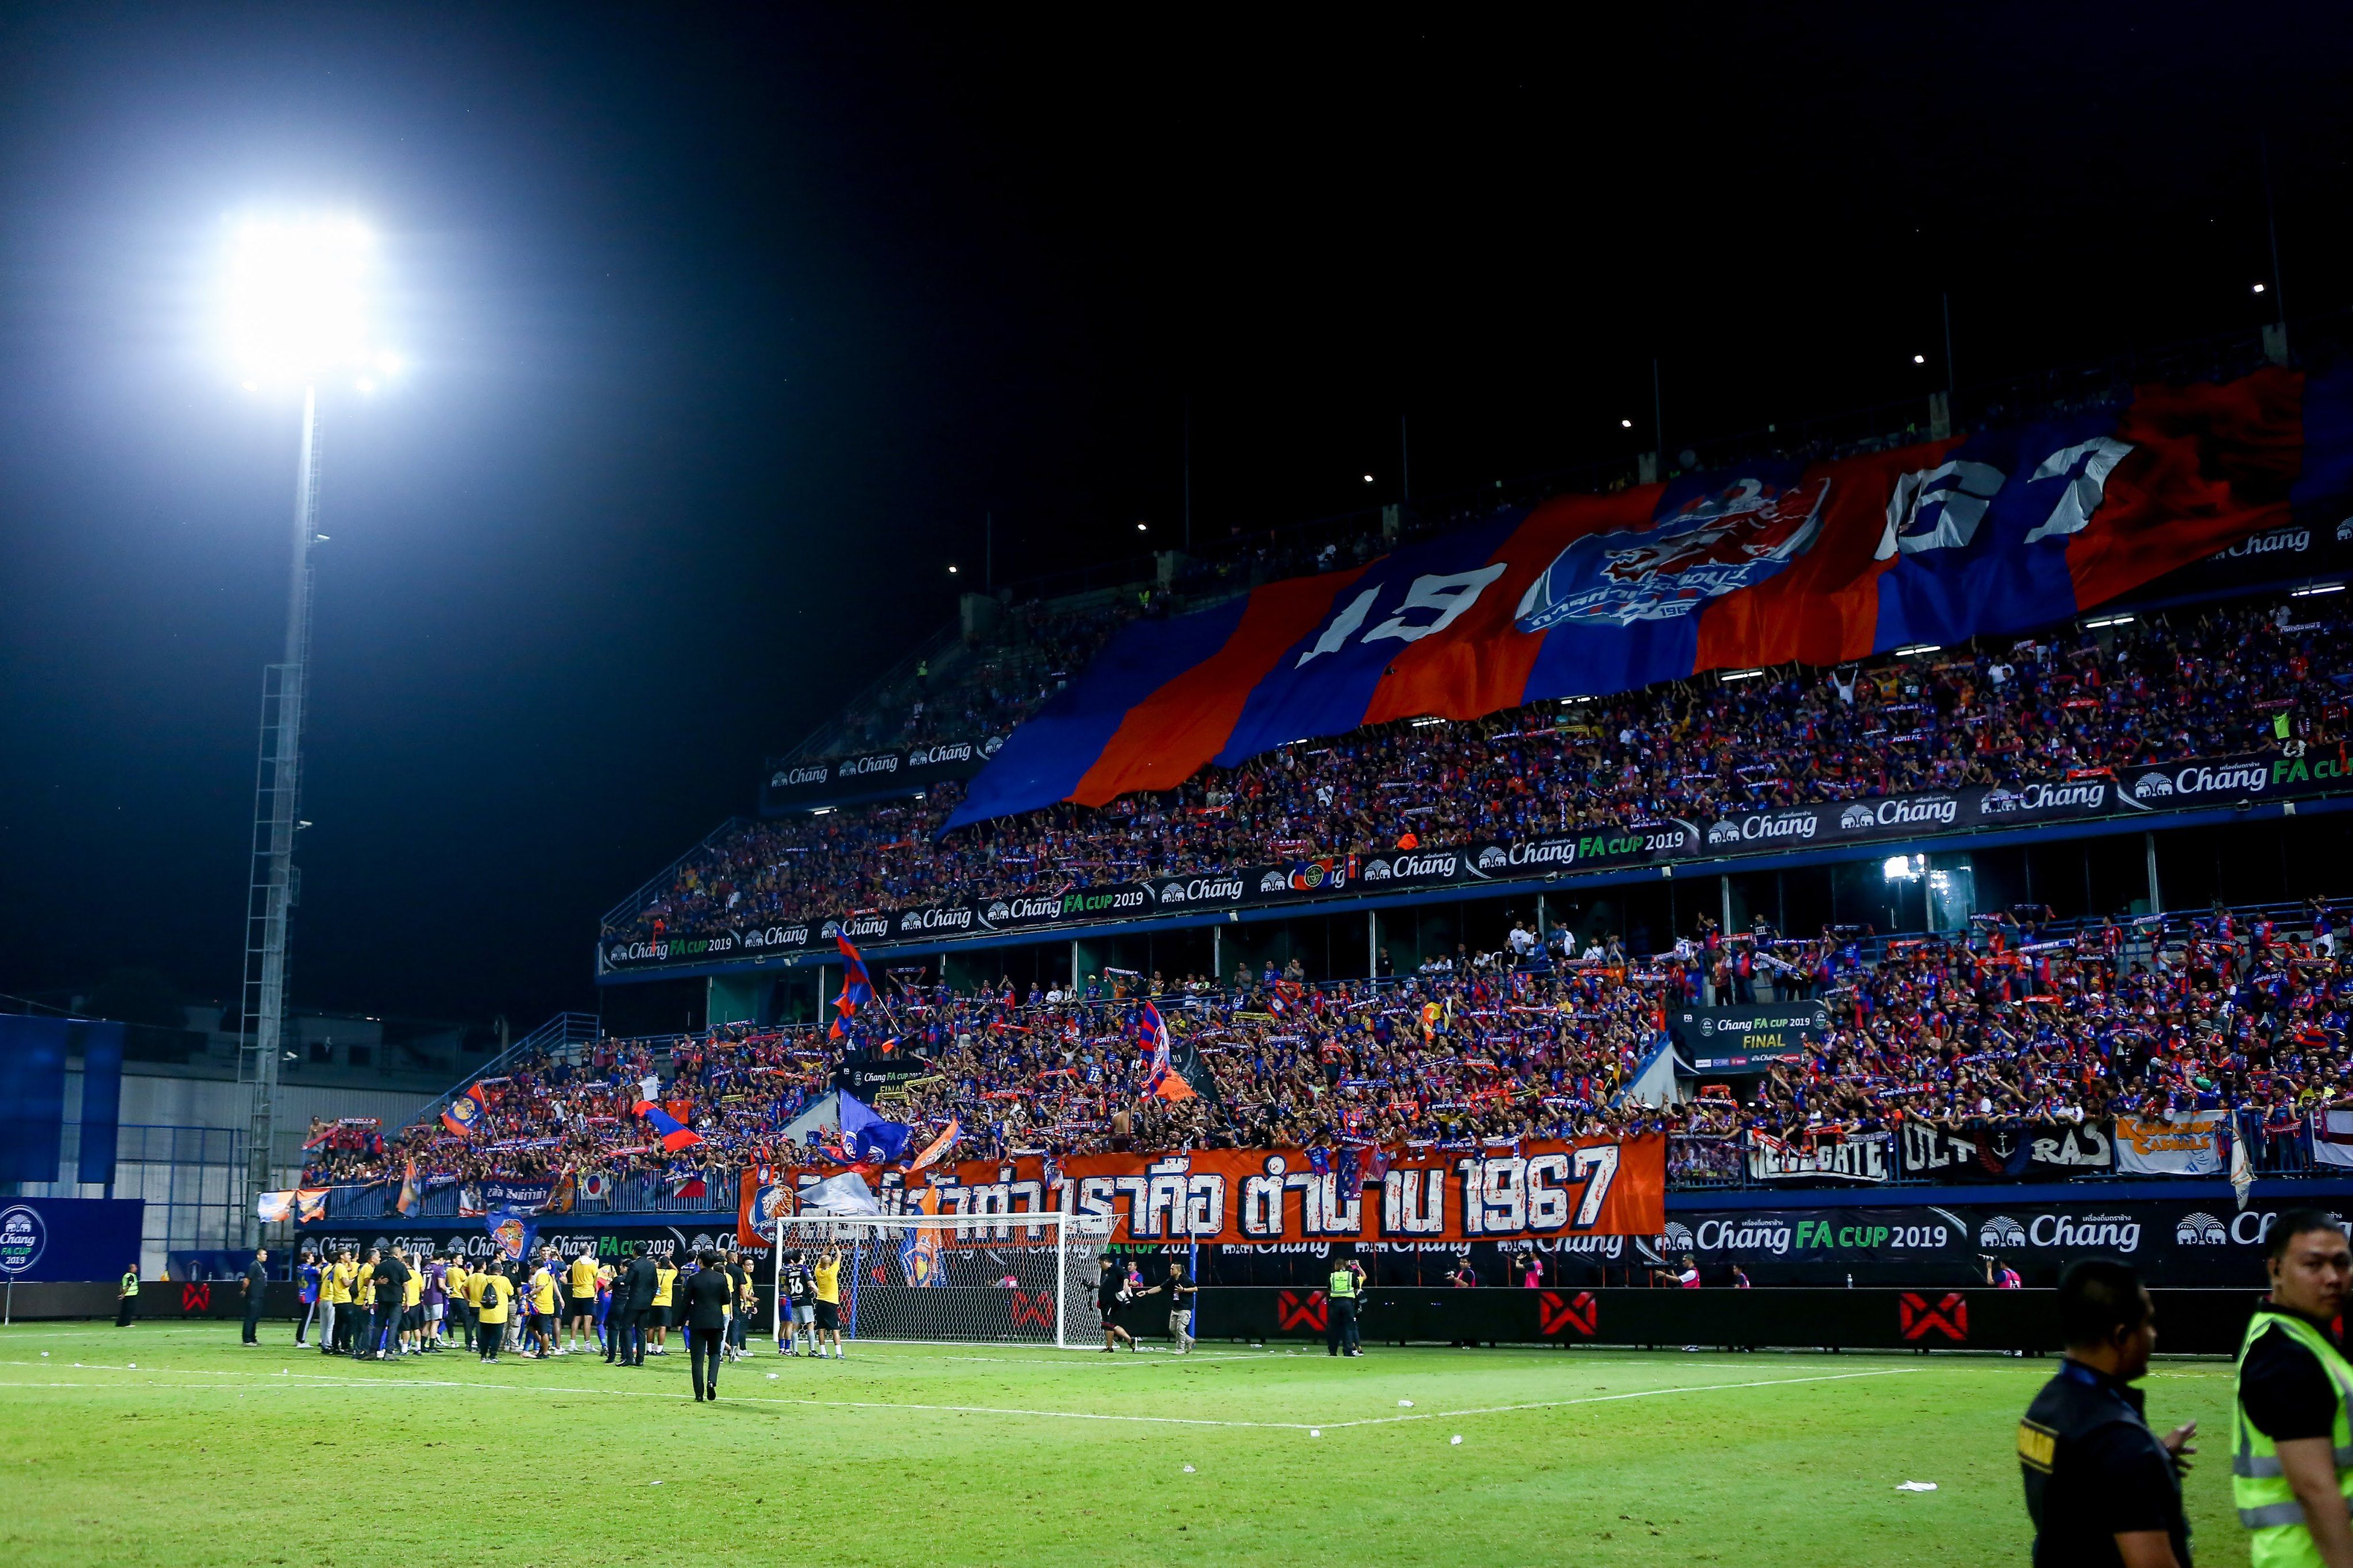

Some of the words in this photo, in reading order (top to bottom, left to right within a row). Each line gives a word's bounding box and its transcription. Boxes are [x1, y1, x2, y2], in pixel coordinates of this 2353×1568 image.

[1294, 563, 1507, 669] 19
[1874, 437, 2135, 561] 67
[1660, 606, 1692, 617] 196
[857, 755, 898, 774] Chang
[928, 745, 971, 764] Chang
[789, 766, 828, 785] Chang
[2176, 766, 2267, 794] Chang
[2273, 759, 2309, 783] FA
[2020, 783, 2105, 809] Chang
[1877, 800, 1958, 825] Chang
[1742, 815, 1818, 840] Chang
[1509, 842, 1576, 864] Chang
[1579, 836, 1605, 858] FA
[1608, 836, 1644, 854] CUP
[1644, 832, 1684, 851] 2019
[1392, 856, 1457, 877] Chang
[1186, 879, 1244, 900] Chang
[1011, 898, 1062, 918] Chang
[1063, 895, 1084, 913] FA
[1086, 894, 1113, 910] CUP
[1113, 891, 1144, 907] 2019
[842, 917, 889, 937] Chang
[923, 909, 972, 928] Chang
[765, 926, 809, 945] Chang
[628, 943, 668, 960] Chang
[669, 940, 686, 956] FA
[687, 939, 708, 954] CUP
[708, 937, 732, 952] 2019
[1718, 1019, 1753, 1032] Chang
[1753, 1018, 1768, 1029] FA
[1770, 1018, 1788, 1027] CUP
[1789, 1017, 1810, 1027] 2019
[1743, 1034, 1786, 1049] FINAL
[864, 1072, 886, 1083] Chang
[887, 1072, 896, 1081] FA
[1088, 1070, 1100, 1082] 22
[1904, 1126, 1977, 1171] ULT
[2031, 1122, 2111, 1166] RAS
[2133, 1135, 2211, 1156] CASUALS
[1457, 1145, 1620, 1234] 1967
[759, 1219, 777, 1229] PORT
[2082, 1214, 2132, 1222] เครื่องดื่มตราช้าง
[0, 1233, 36, 1247] Chang
[1696, 1219, 1791, 1254] Chang
[1796, 1221, 1834, 1248] FA
[1839, 1226, 1888, 1248] CUP
[1891, 1225, 1947, 1248] 2019
[2030, 1214, 2141, 1253] Chang
[1, 1248, 11, 1256] FA
[14, 1248, 33, 1256] CUP
[319, 1236, 361, 1257] Chang
[394, 1236, 435, 1258] Chang
[467, 1236, 499, 1257] Cha
[550, 1235, 598, 1259] Chag
[599, 1236, 619, 1256] FA
[647, 1239, 675, 1256] 2019
[1537, 1235, 1623, 1259] Chang
[5, 1256, 26, 1265] 2019
[789, 1277, 804, 1295] 36
